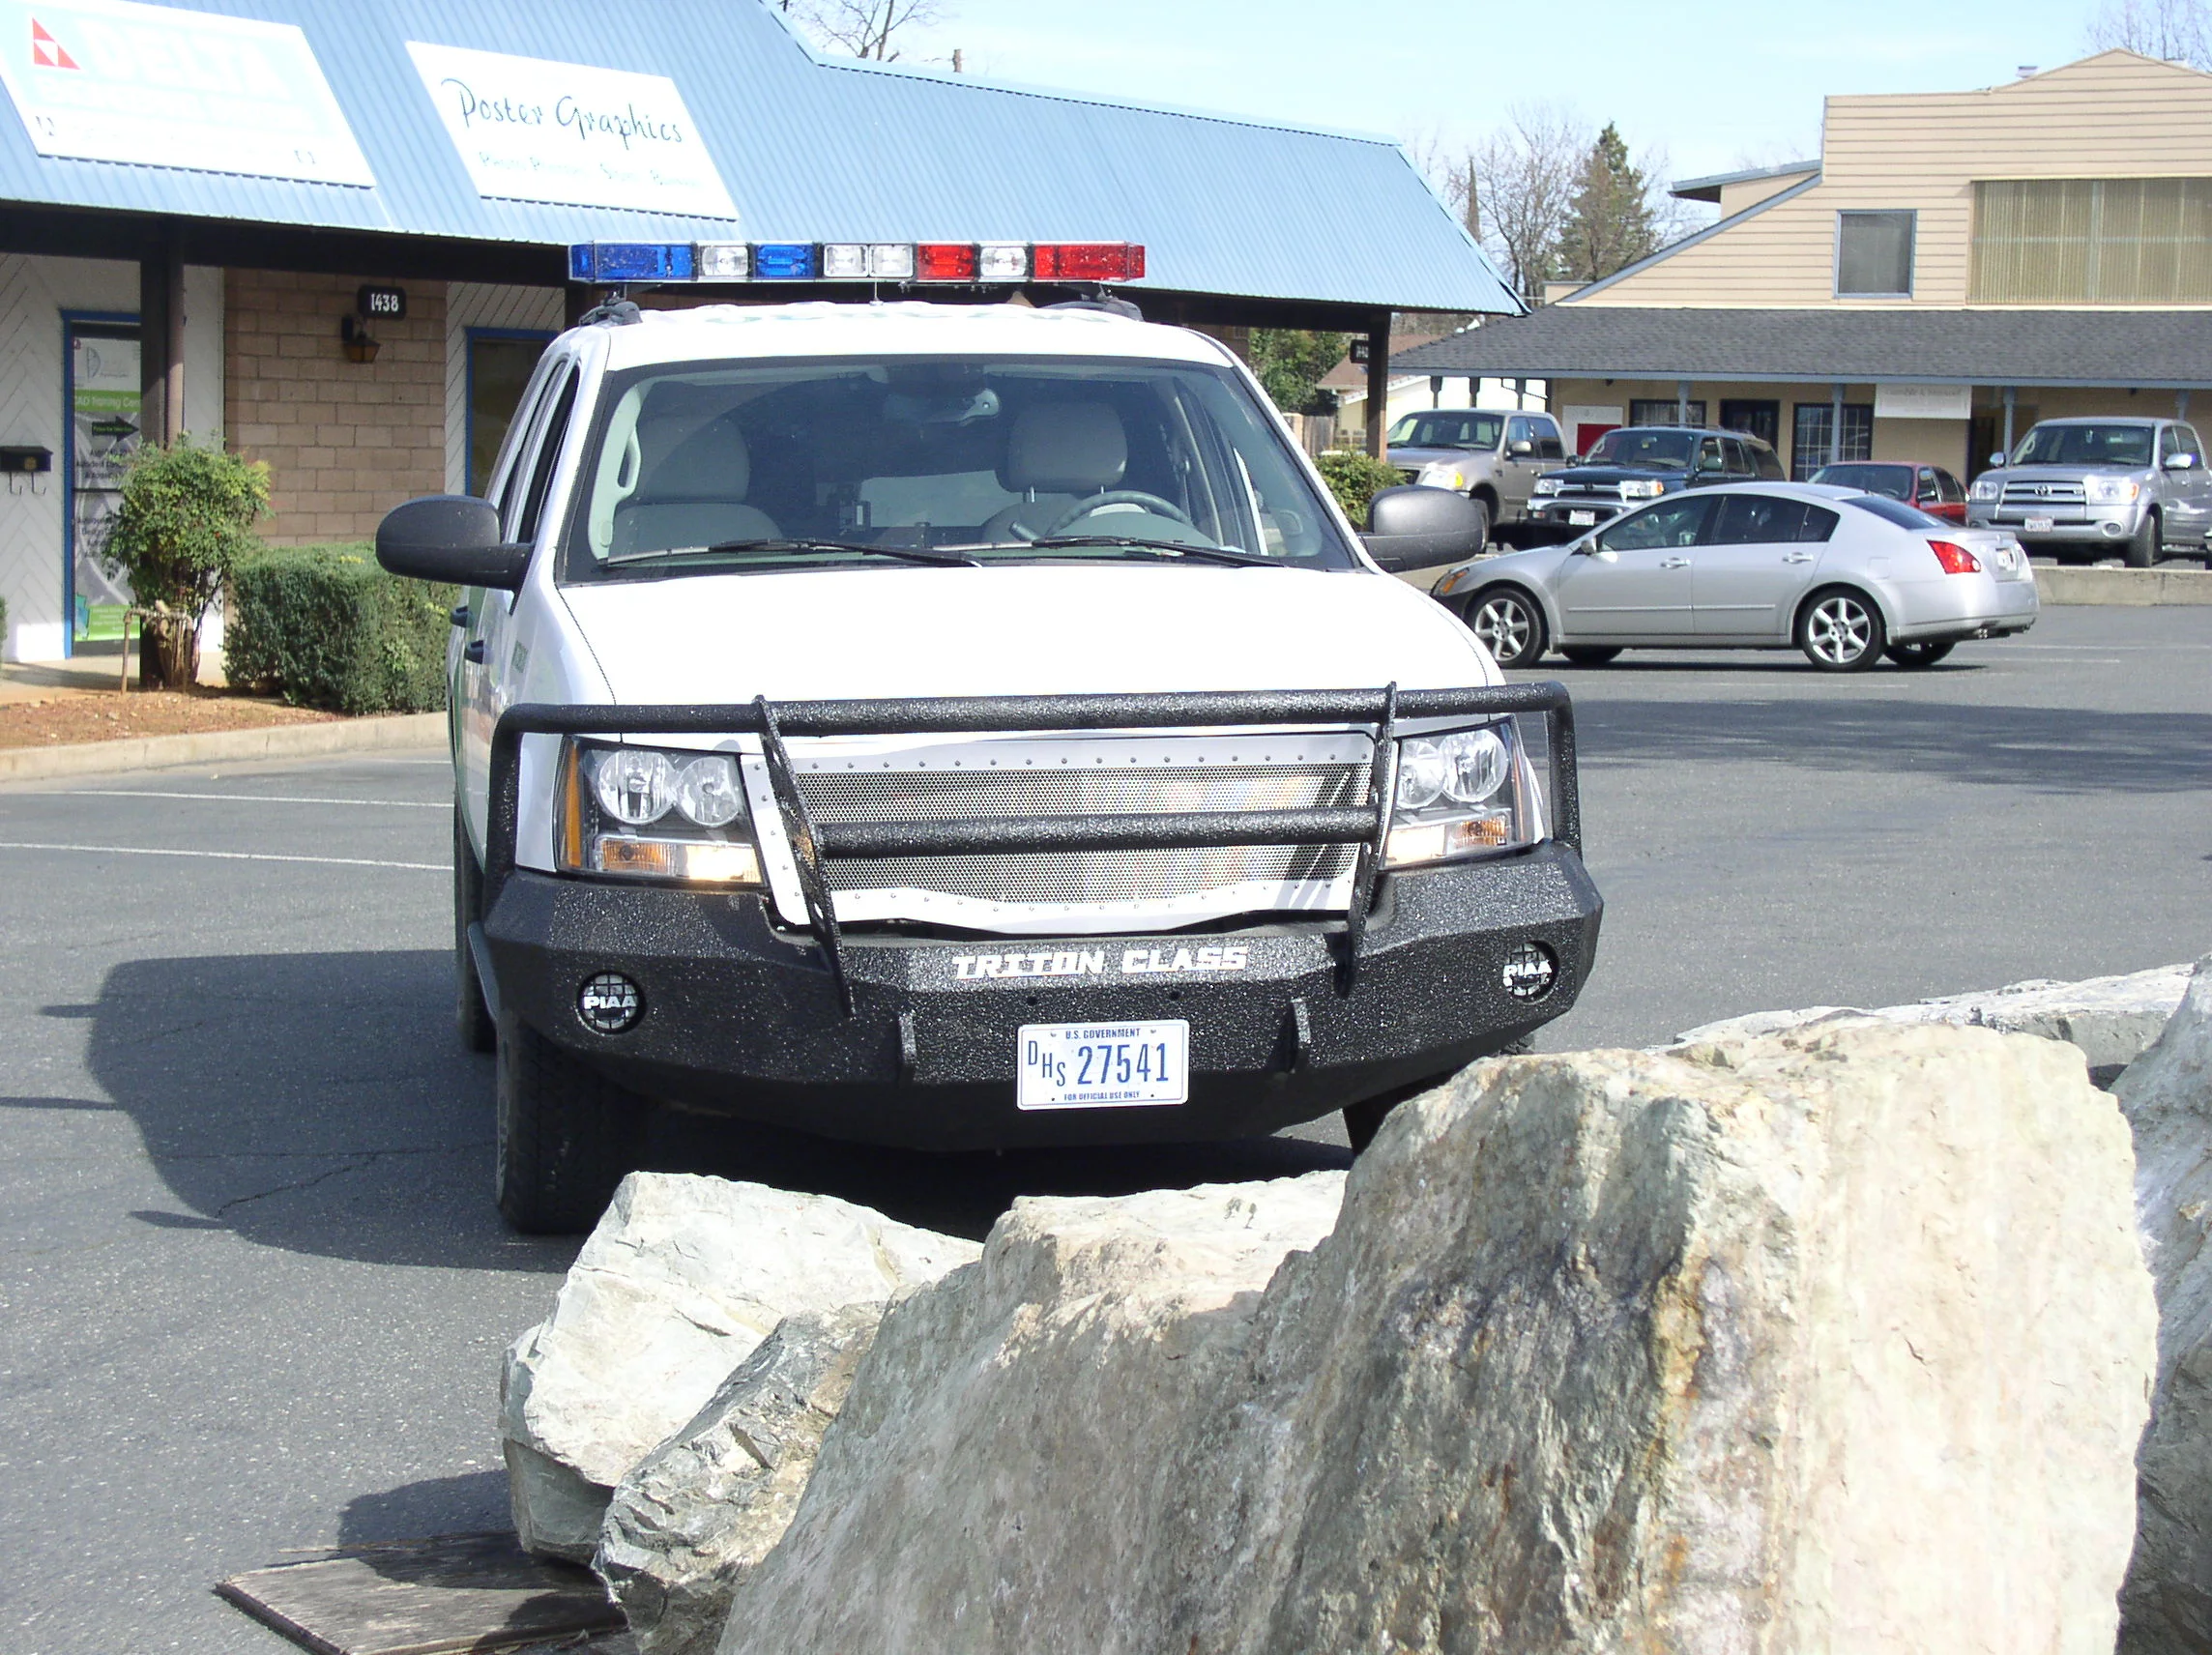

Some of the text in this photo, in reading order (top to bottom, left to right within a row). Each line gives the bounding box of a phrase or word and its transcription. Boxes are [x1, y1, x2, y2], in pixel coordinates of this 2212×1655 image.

[440, 78, 684, 150] Poster Graphics
[370, 293, 399, 312] 1438
[952, 945, 1249, 980] TRITON CLASS
[583, 996, 637, 1009] PIAA
[1065, 1028, 1141, 1039] U.S. GOVERNMENT
[1077, 1043, 1169, 1086] 27541
[1078, 1091, 1108, 1100] OFFICIAL
[1109, 1091, 1122, 1100] USE
[1123, 1090, 1140, 1099] ONLY
